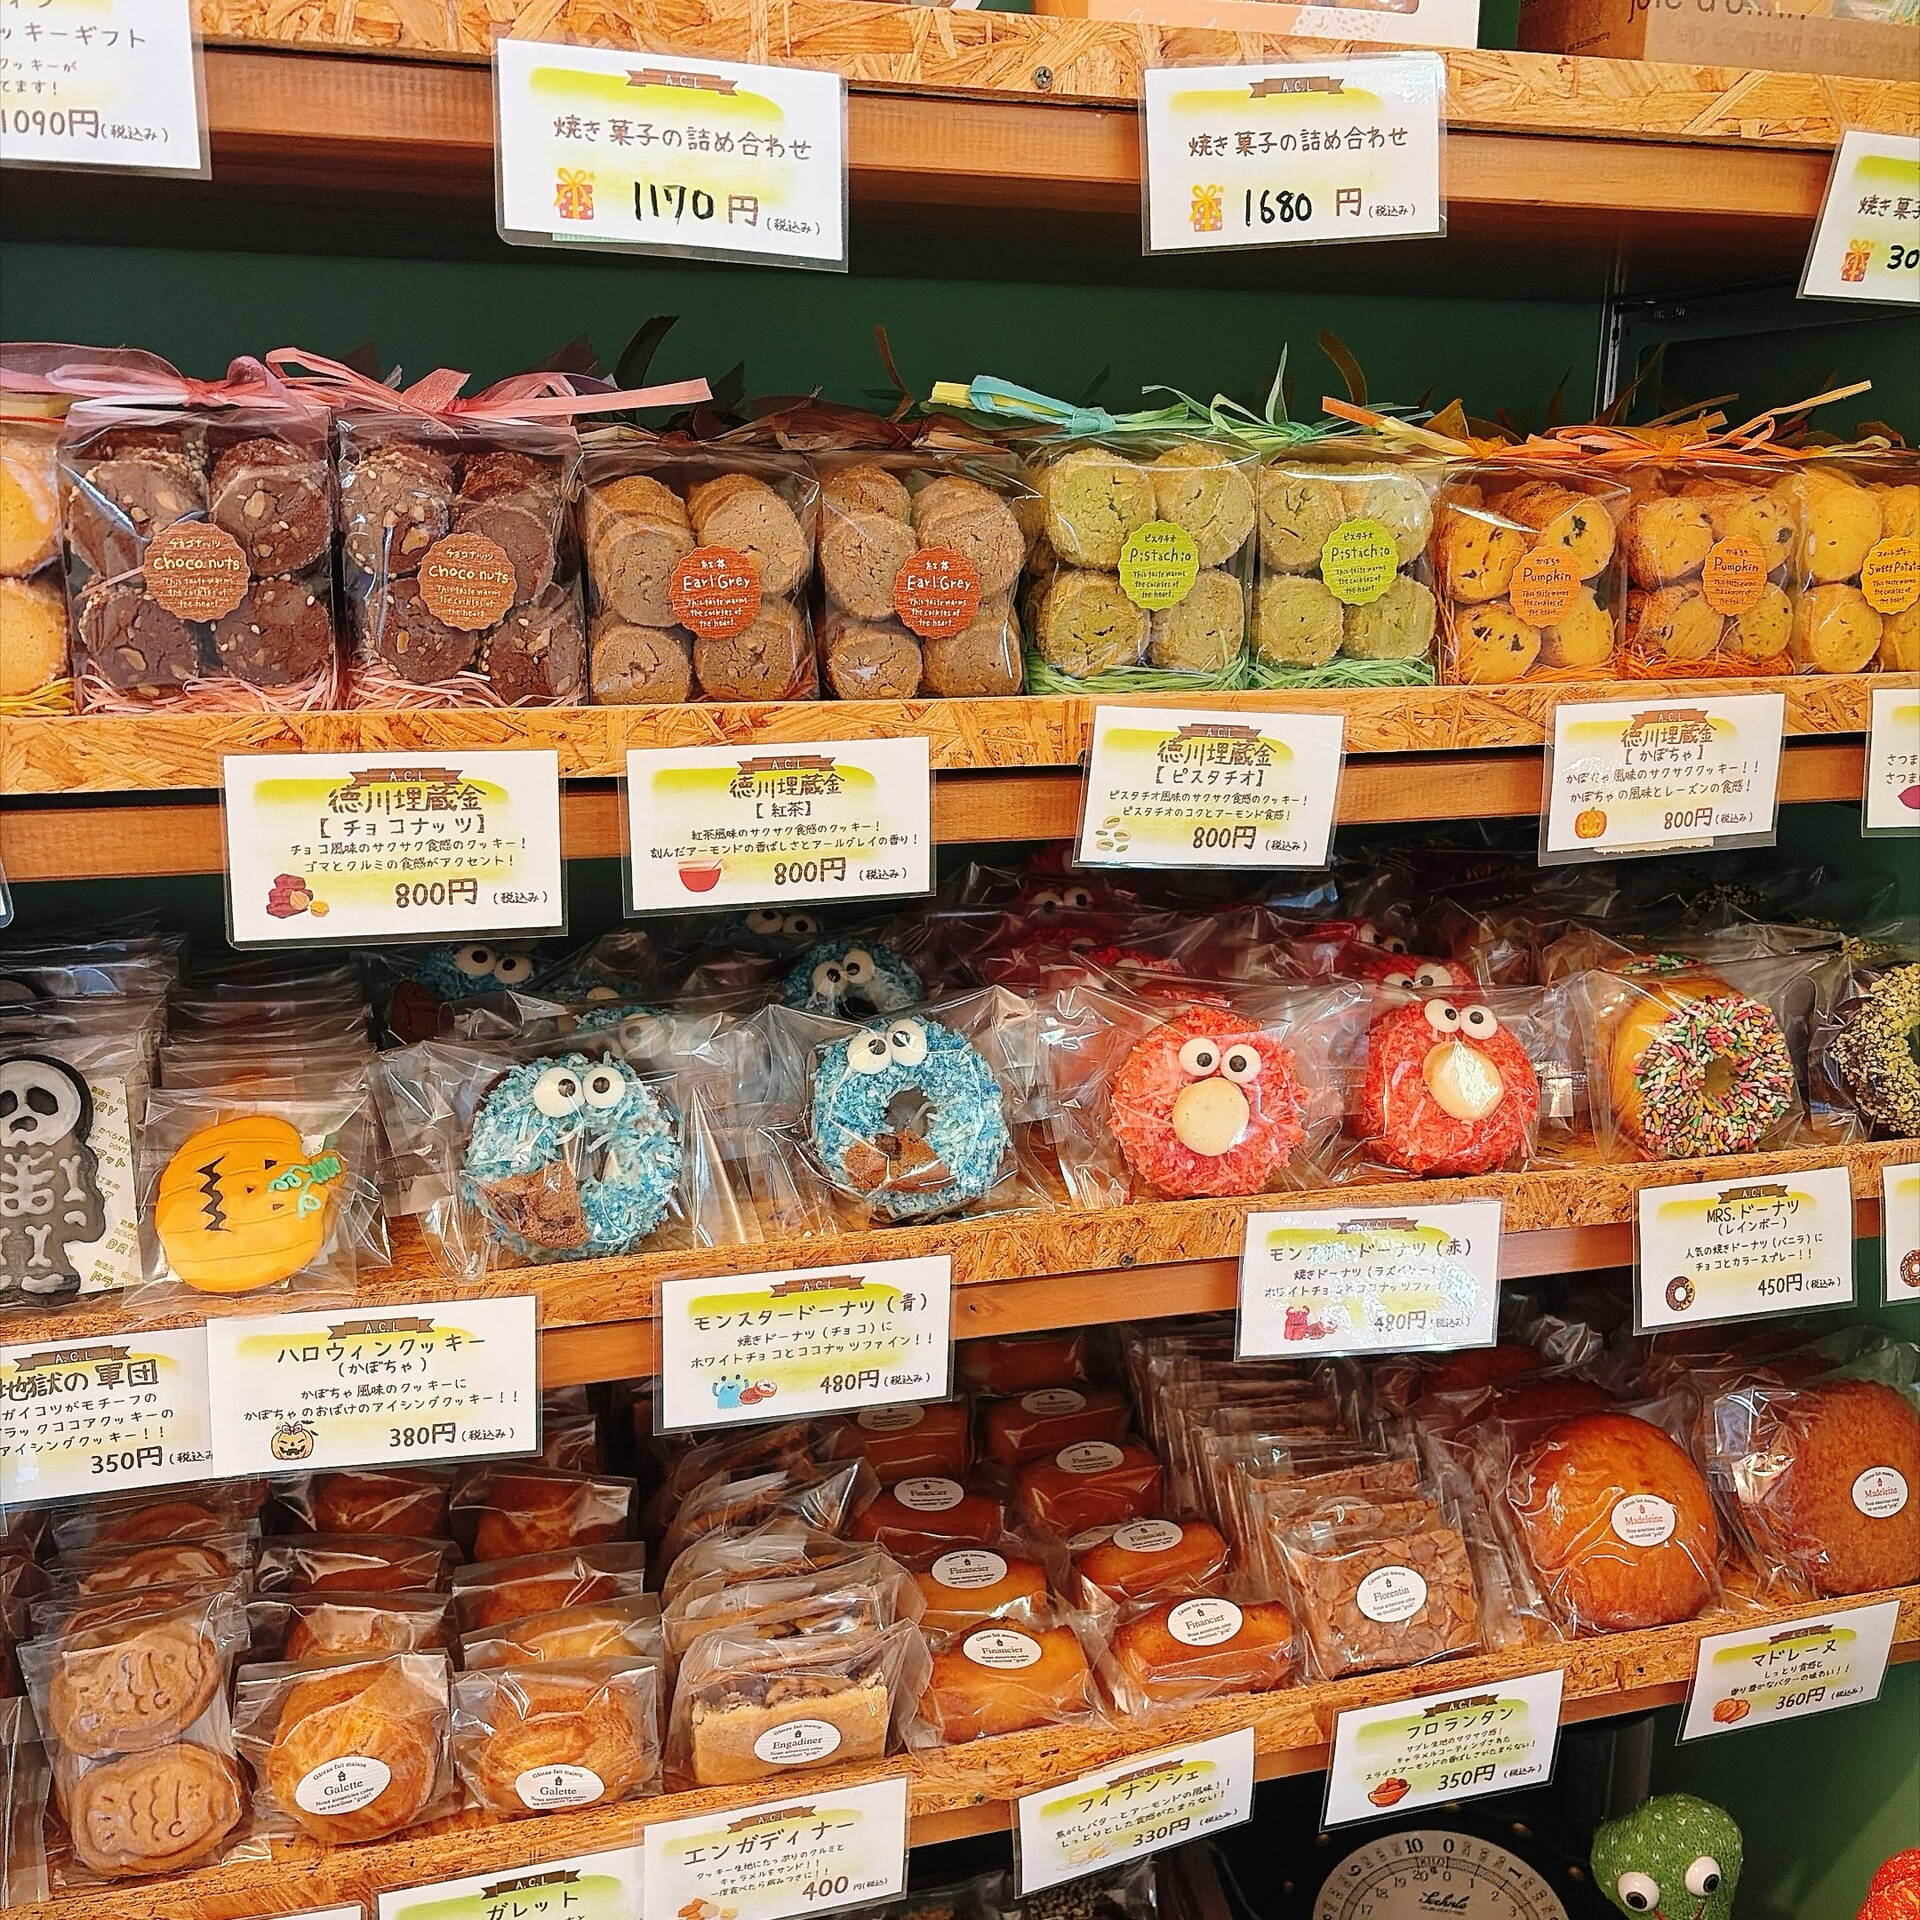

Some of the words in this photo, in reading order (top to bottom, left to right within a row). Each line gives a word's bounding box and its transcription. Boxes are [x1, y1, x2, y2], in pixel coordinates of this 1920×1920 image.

[1, 109, 99, 138] 1090円
[554, 114, 811, 161] 焼き菓子の詰め合わせ
[1189, 126, 1408, 157] 焼き菓子の詰め合わせ
[635, 182, 714, 224] 1170
[728, 193, 759, 227] 円
[1245, 189, 1312, 226] 1680
[1336, 188, 1362, 217] 円
[1130, 547, 1191, 563] Pistachio
[1331, 544, 1390, 562] Pistachio
[1714, 557, 1758, 575] Pumpkin
[683, 575, 714, 591] Earl
[718, 574, 750, 589] Grey
[907, 575, 936, 590] Earl
[940, 575, 971, 590] Grey
[1522, 568, 1571, 584] Pumpkin
[1869, 563, 1893, 576] Sweet
[1621, 723, 1717, 748] 徳川埋蔵金
[1157, 740, 1277, 767] 徳川埋蔵金
[729, 774, 846, 799] 徳川埋蔵金
[328, 784, 487, 816] 徳川埋蔵金
[1664, 807, 1712, 829] 800円
[1193, 826, 1256, 849] 800円
[774, 857, 846, 886] 800円
[395, 878, 478, 908] 800円
[1758, 1273, 1803, 1297] 450円
[278, 1333, 486, 1363] ハロウィンクッキー
[820, 1369, 879, 1395] 480円
[0, 1409, 173, 1438] ラックココアクッキーの
[389, 1422, 456, 1448] 380円
[91, 1446, 163, 1474] 350円
[1752, 1639, 1836, 1668] マドレーヌ
[1775, 1686, 1826, 1710] 360円
[1406, 1708, 1513, 1739] フロランタン
[324, 1780, 363, 1796] Galette
[1438, 1763, 1496, 1791] 350円
[540, 1787, 577, 1795] Galette
[1079, 1770, 1200, 1813] フィナンシェ
[684, 1821, 854, 1866] エンガディナー
[1133, 1816, 1191, 1847] 330円
[1406, 1837, 1424, 1854] 10
[1443, 1839, 1455, 1853] 0
[801, 1875, 848, 1901] 400
[1393, 1877, 1407, 1889] 19
[1412, 1870, 1429, 1882] 20
